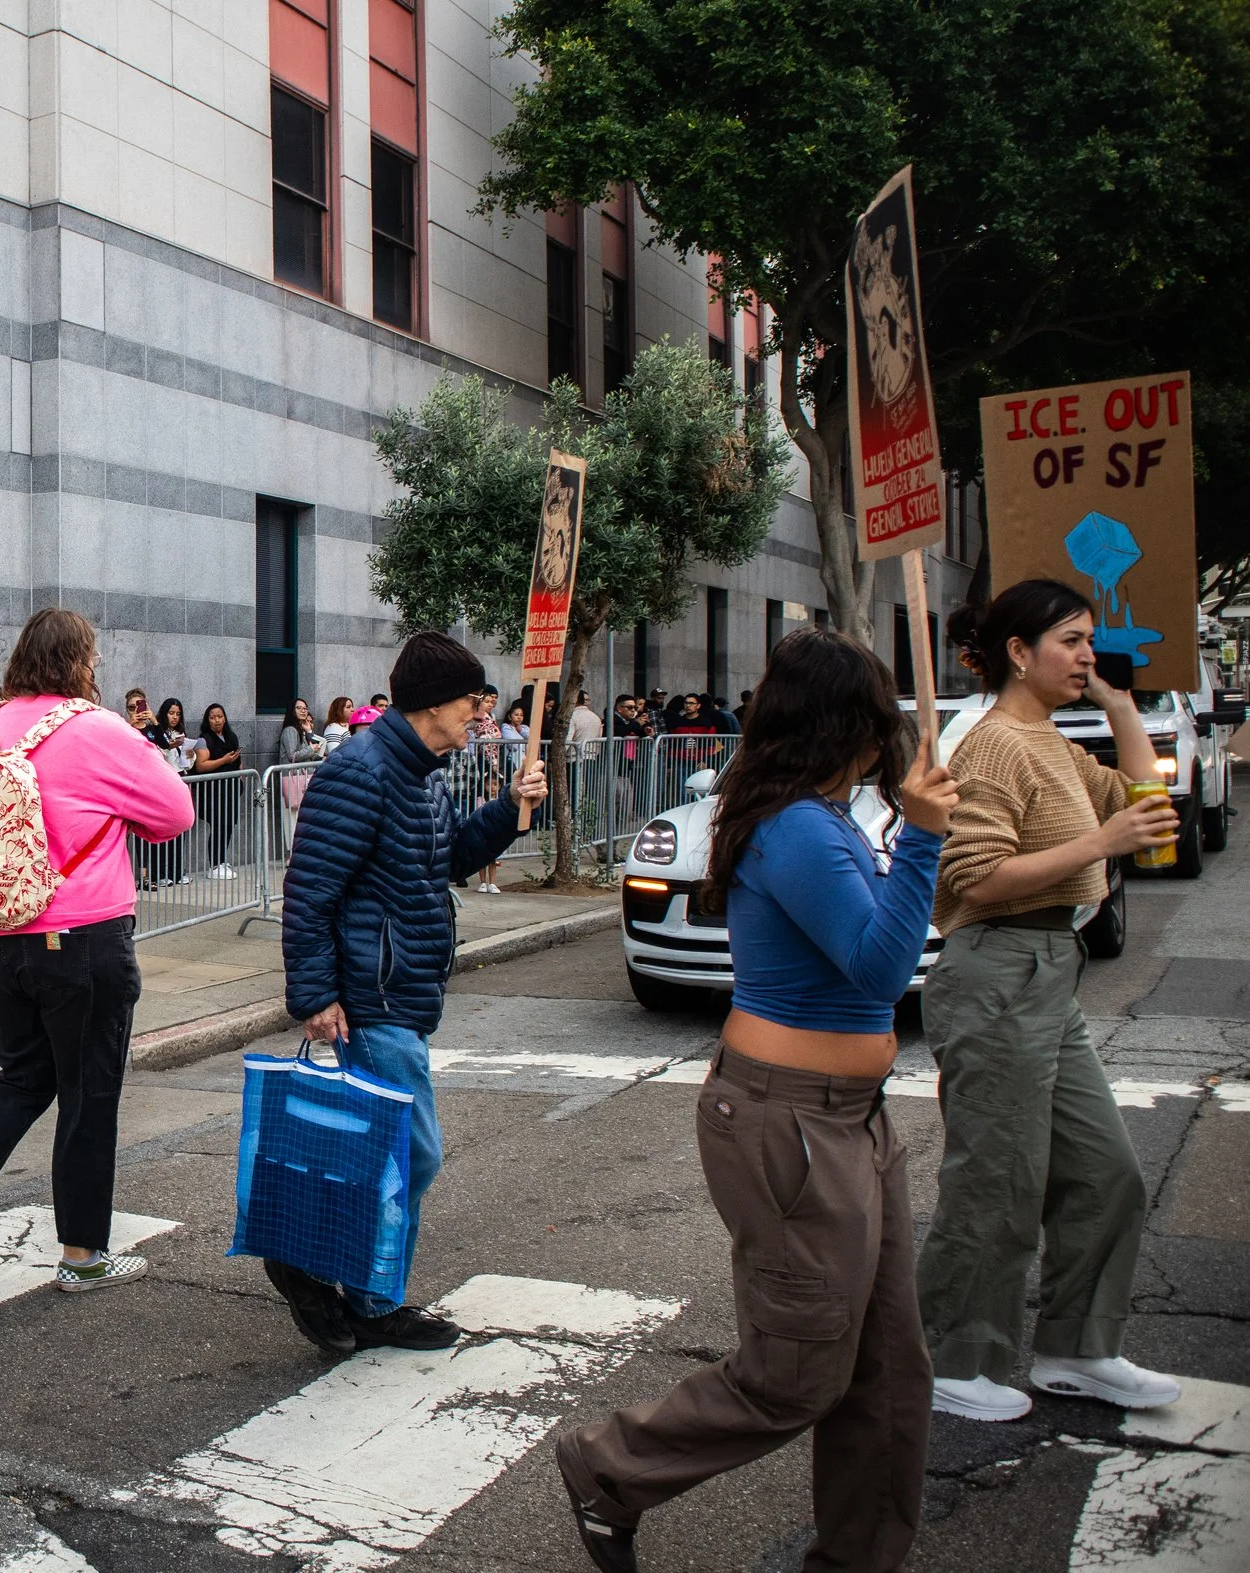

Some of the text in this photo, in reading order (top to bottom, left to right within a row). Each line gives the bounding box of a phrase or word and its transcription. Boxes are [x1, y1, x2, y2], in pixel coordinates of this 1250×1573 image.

[1005, 379, 1184, 440] I.C.E. OUT
[915, 466, 926, 489] 24
[1033, 438, 1167, 489] OF SF
[907, 489, 938, 524] STRIKE
